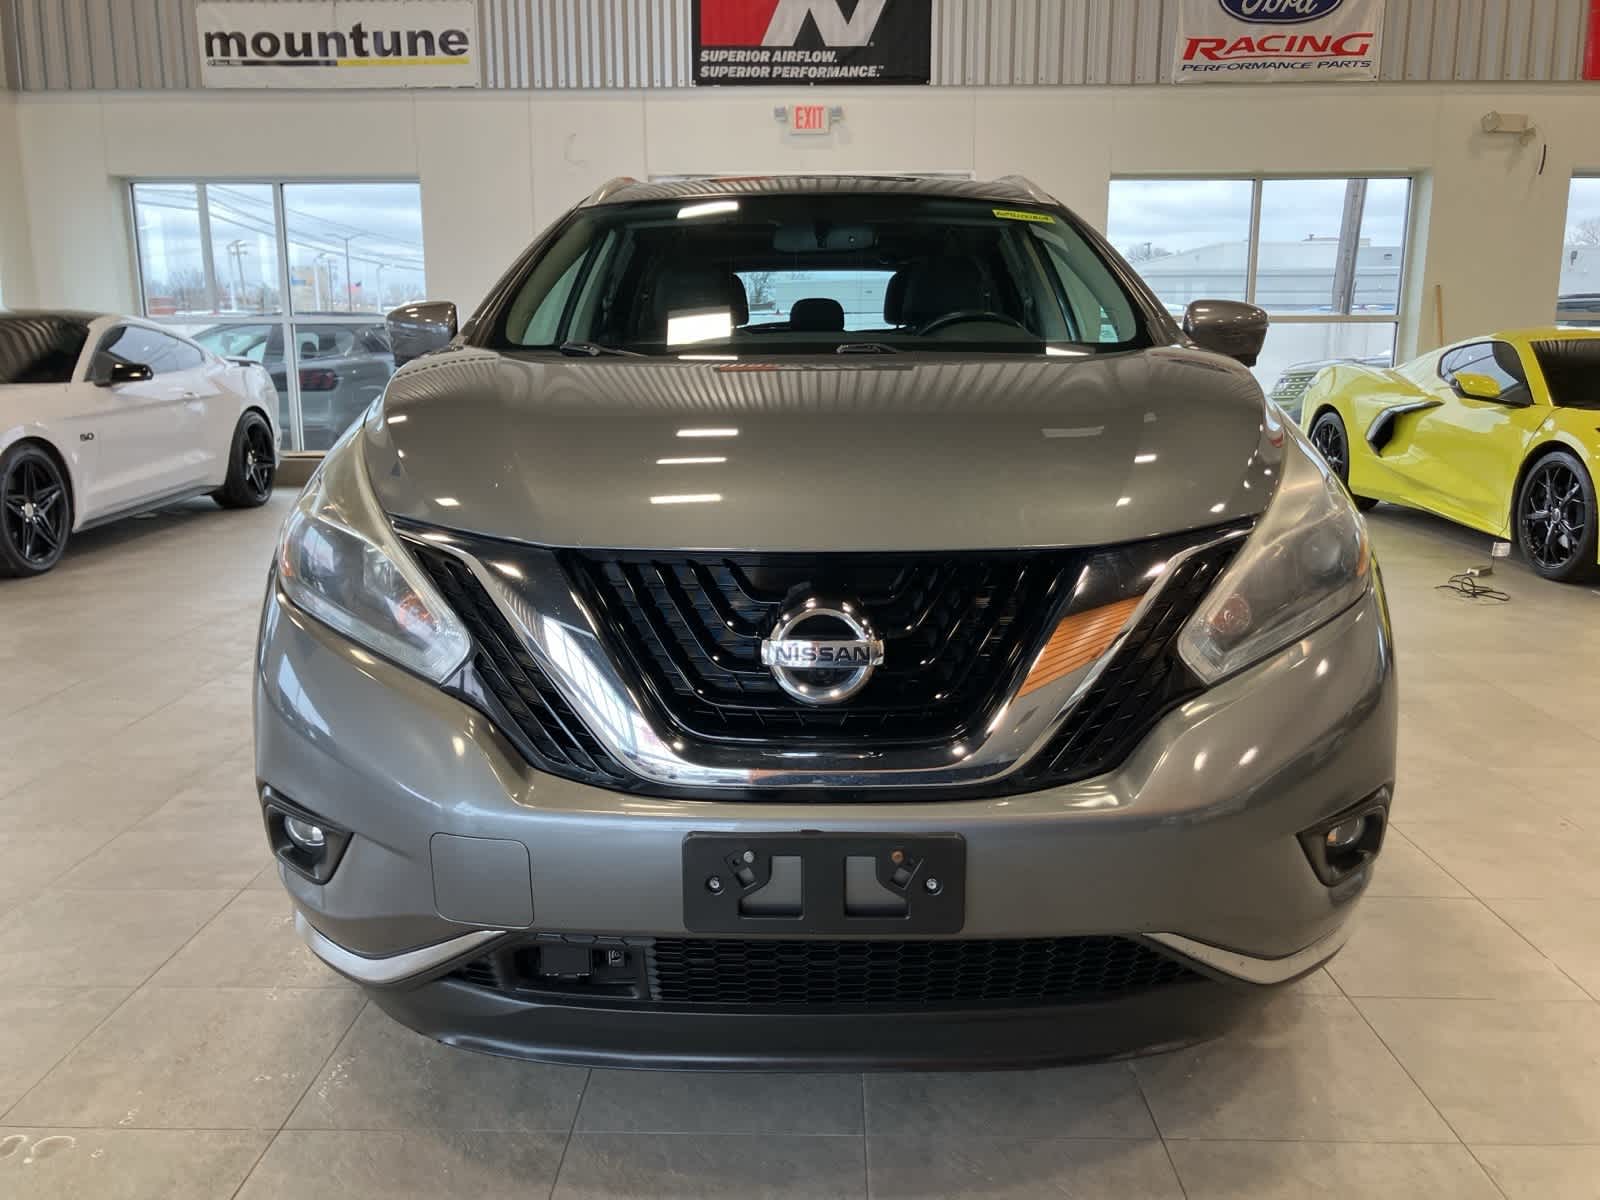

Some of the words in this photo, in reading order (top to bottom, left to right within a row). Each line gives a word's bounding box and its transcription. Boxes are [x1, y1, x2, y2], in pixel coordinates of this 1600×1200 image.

[204, 22, 470, 57] mountune
[1182, 33, 1373, 60] RACING
[700, 50, 770, 62] SUPERIOR
[772, 50, 838, 63] AIRFLOW.
[700, 66, 770, 78] SUPERIOR
[1181, 61, 1312, 71] PERFORMANCE
[1317, 60, 1372, 69] PARTS
[796, 106, 824, 129] EXIT
[775, 646, 871, 662] NISSAN
